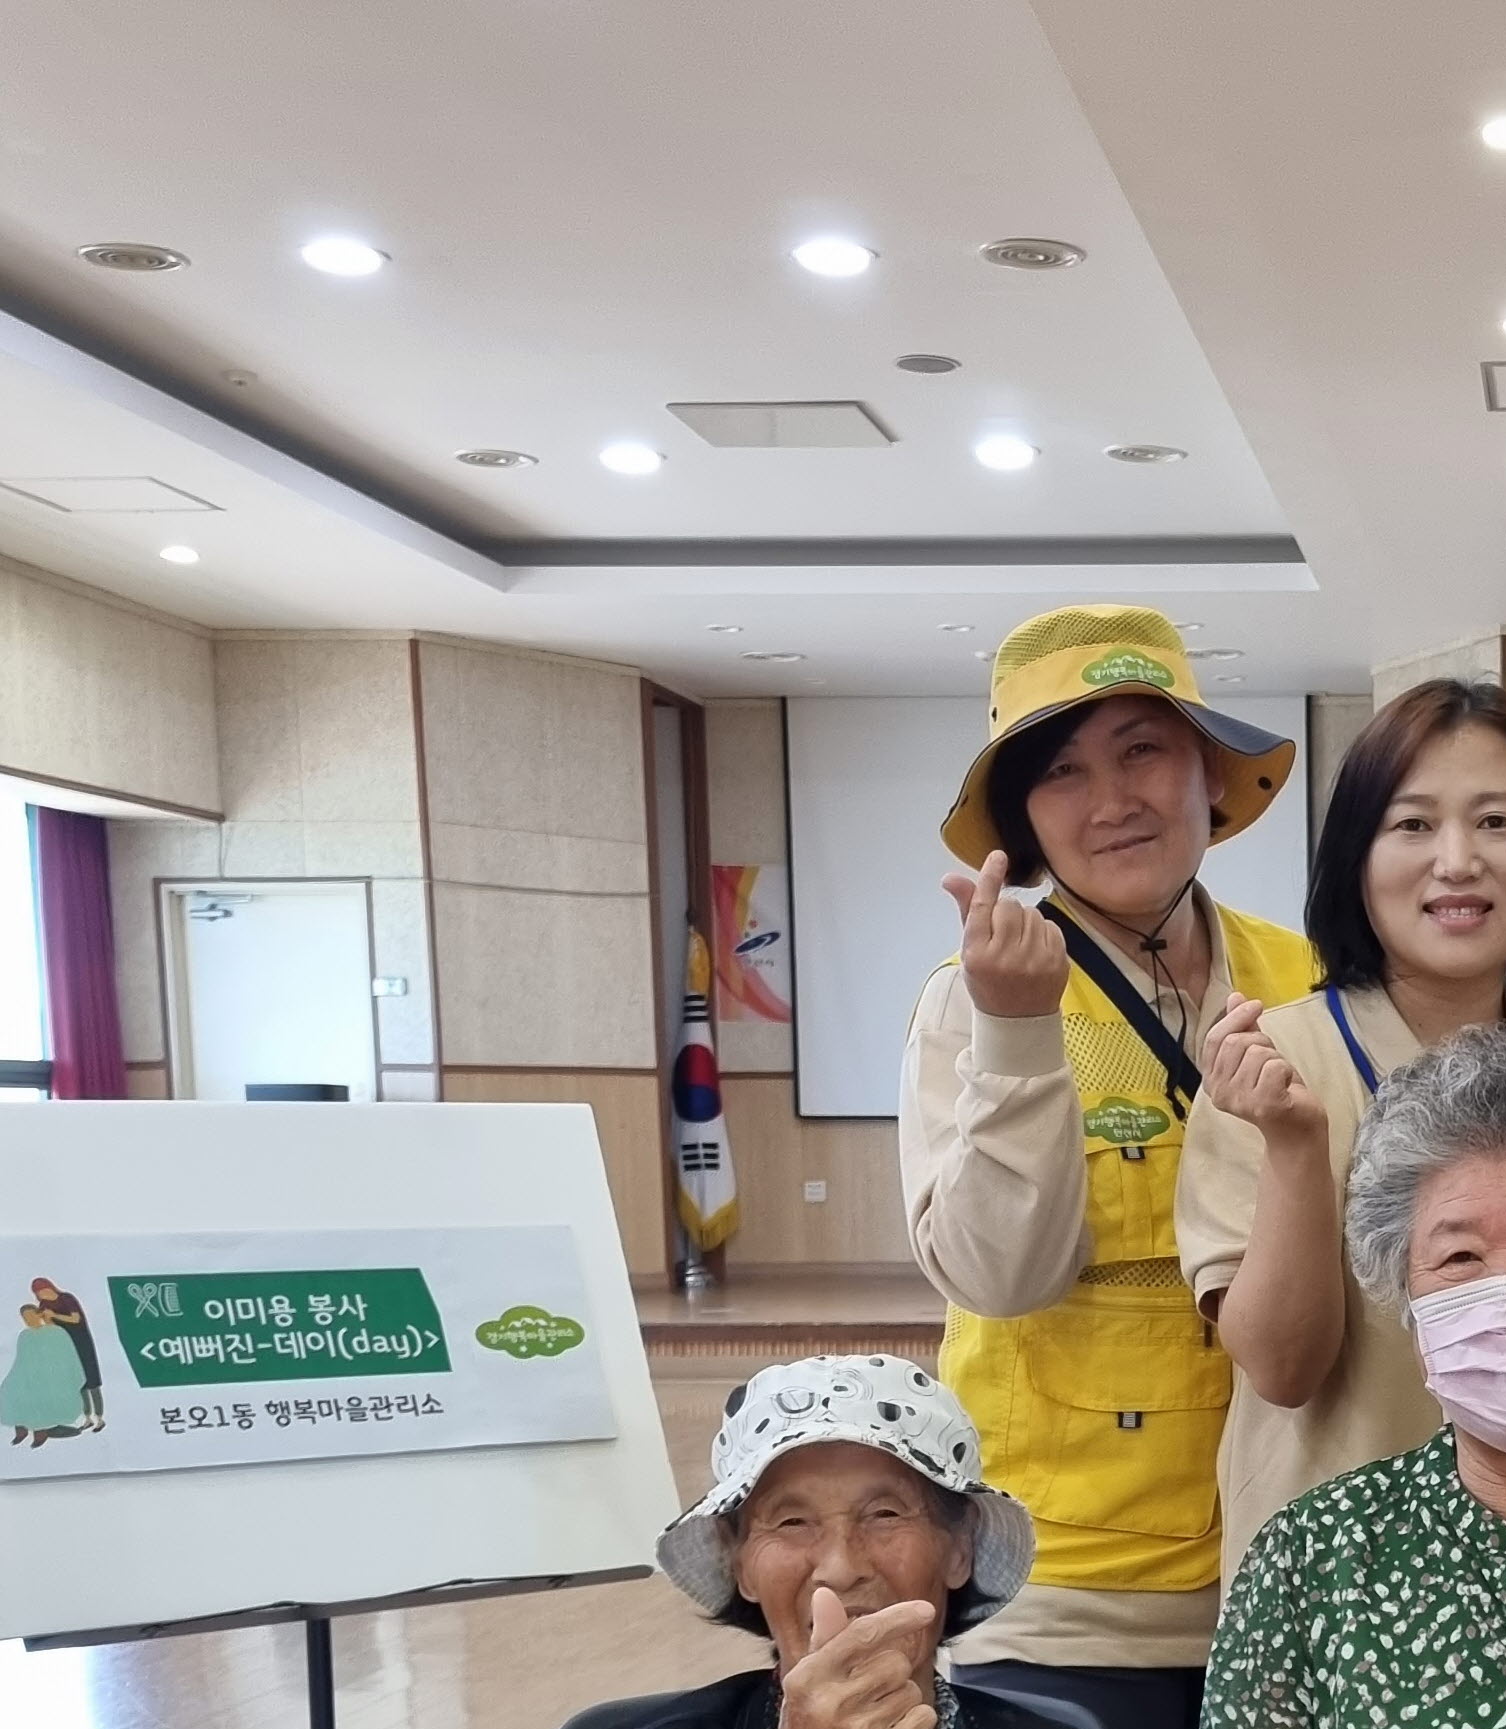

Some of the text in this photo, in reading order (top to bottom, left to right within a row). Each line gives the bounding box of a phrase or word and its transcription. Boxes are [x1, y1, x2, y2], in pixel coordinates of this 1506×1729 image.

[203, 1293, 368, 1328] 이미용 봉사
[139, 1323, 441, 1365] <예뻐진-데이(day)>
[159, 1392, 445, 1434] 본오1동 행복마을관리소
